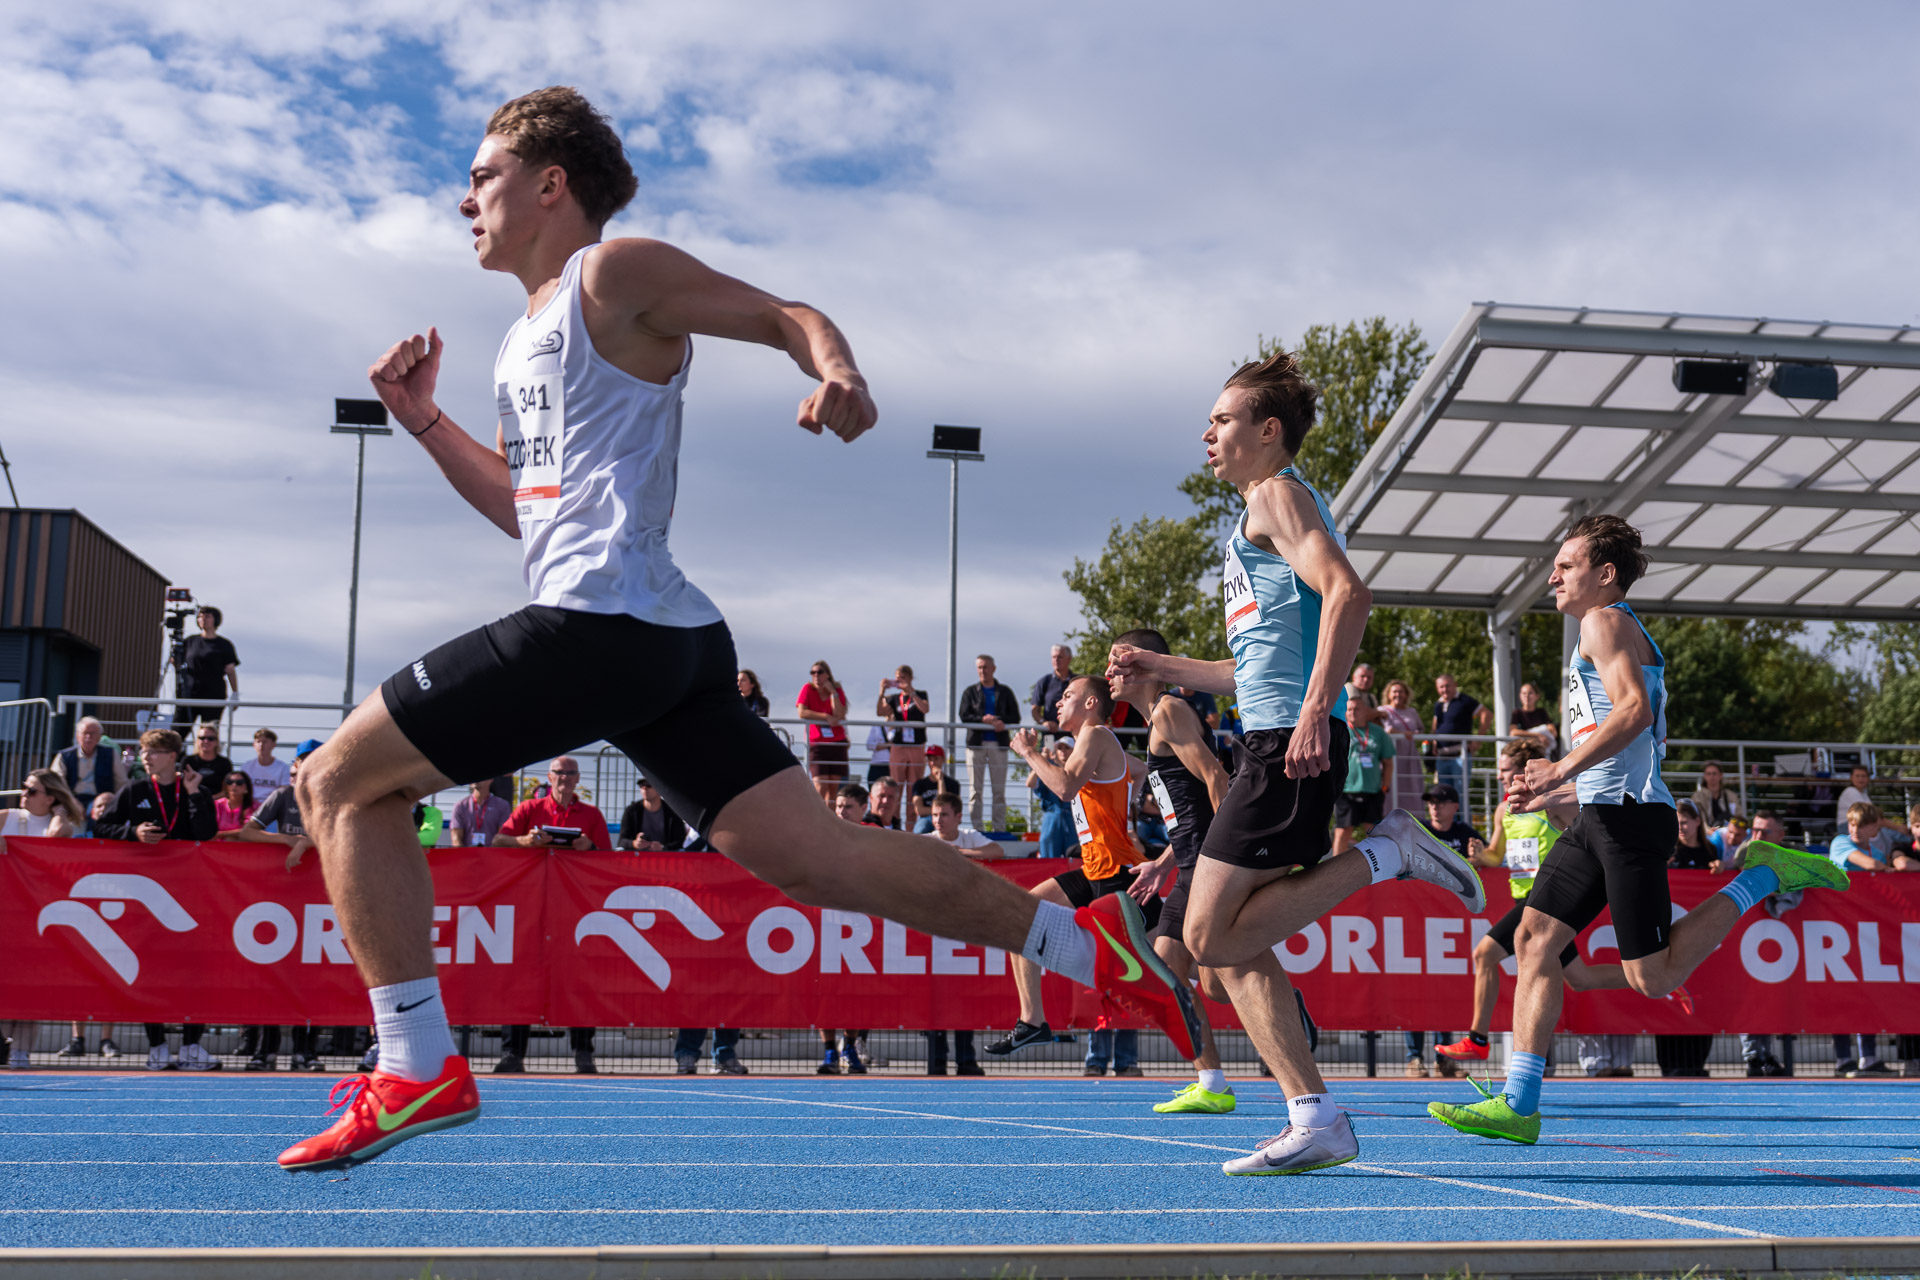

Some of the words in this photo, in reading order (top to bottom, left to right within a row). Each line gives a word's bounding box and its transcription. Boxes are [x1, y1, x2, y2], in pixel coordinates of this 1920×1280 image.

[519, 383, 551, 414] 341
[1224, 572, 1248, 606] ZYK
[412, 660, 432, 690] JAKO
[1295, 1096, 1322, 1107] PUMA
